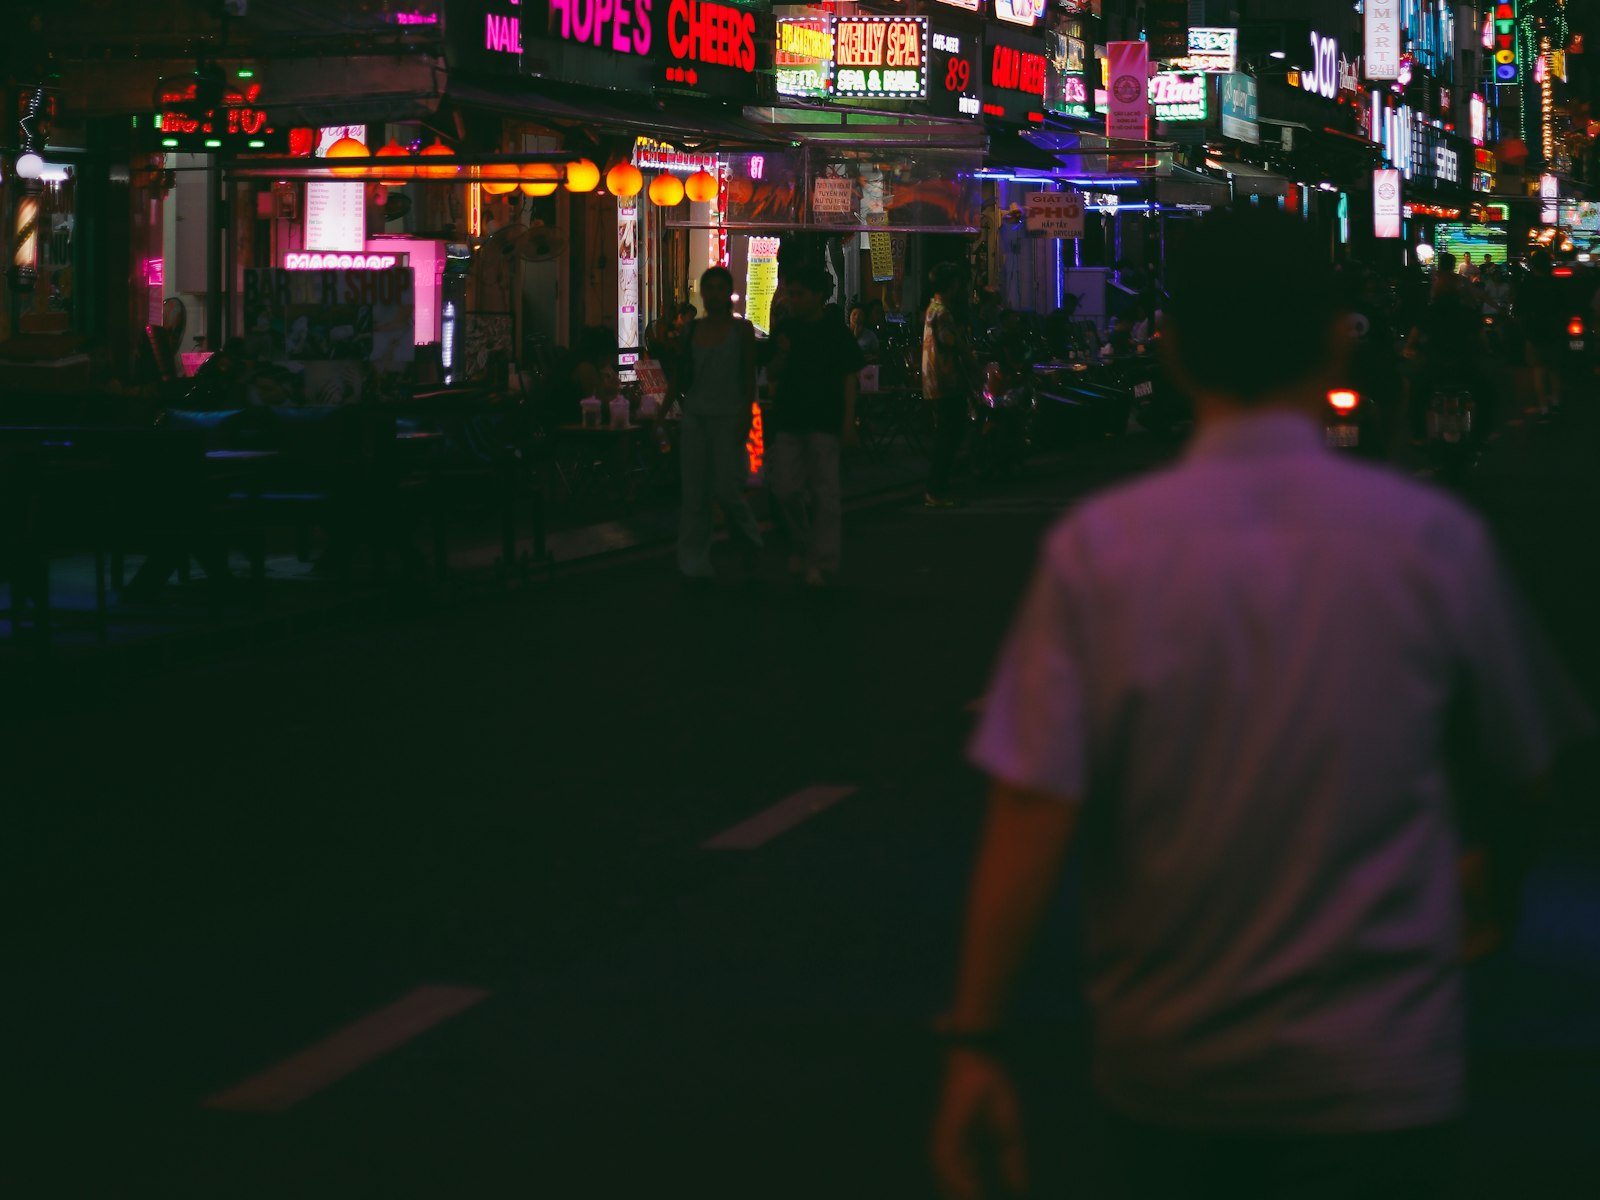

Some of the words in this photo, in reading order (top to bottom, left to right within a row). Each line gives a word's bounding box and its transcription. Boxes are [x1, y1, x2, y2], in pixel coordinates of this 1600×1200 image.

[486, 13, 524, 55] NAIL
[837, 22, 886, 66] KELLY
[886, 22, 920, 67] SPA
[837, 69, 866, 91] SPA
[867, 69, 882, 91] &
[883, 69, 920, 91] NAIL
[945, 57, 969, 91] 89
[992, 44, 1020, 89] COLD
[1020, 51, 1046, 96] BEER
[1368, 63, 1396, 76] 24H
[750, 155, 765, 179] 87
[1028, 203, 1080, 219] PHÚ
[752, 242, 778, 255] MASSAGE
[344, 268, 411, 305] SHOP
